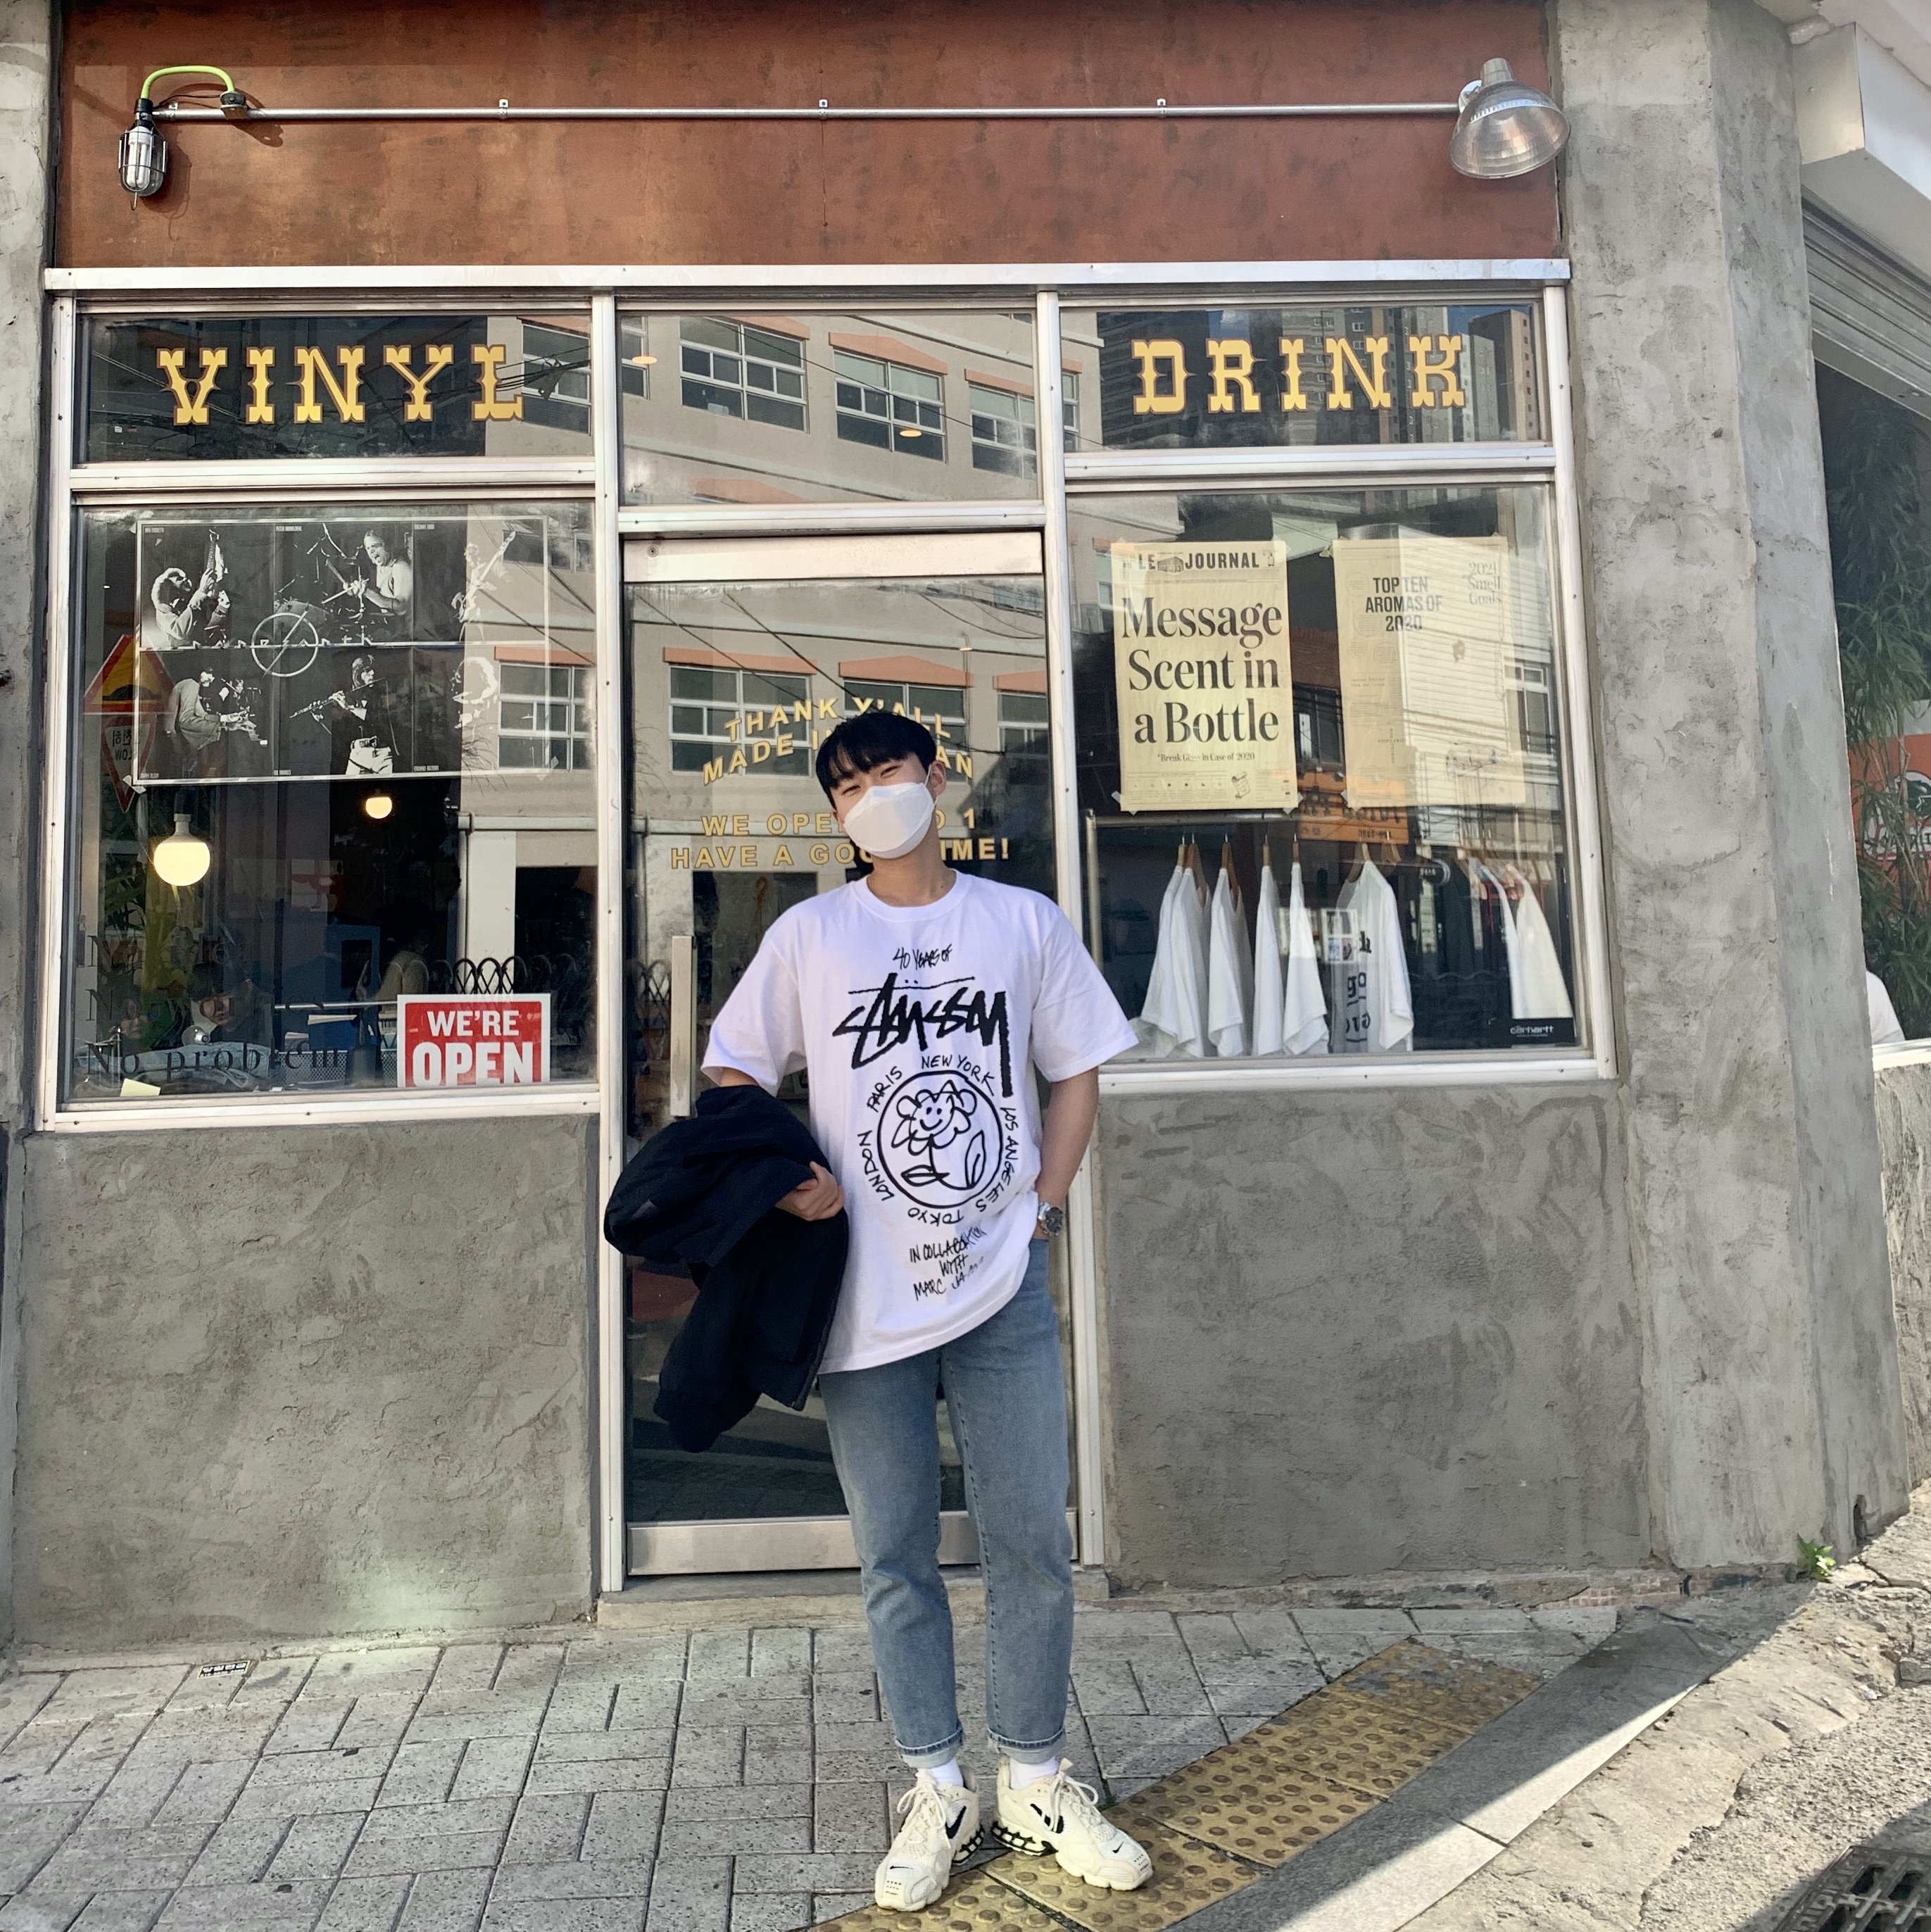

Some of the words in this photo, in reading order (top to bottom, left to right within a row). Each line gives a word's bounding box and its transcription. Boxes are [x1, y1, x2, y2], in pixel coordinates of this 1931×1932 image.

[156, 344, 524, 425] VINYL
[1131, 334, 1465, 415] DRINK
[1139, 553, 1156, 570] LE
[1185, 553, 1259, 570] JOURNAL
[1373, 577, 1399, 594] TOP
[1404, 576, 1429, 593] TEN
[1468, 575, 1502, 591] Smell
[1366, 596, 1424, 613] AROMAS
[1426, 595, 1443, 611] OF
[1122, 597, 1283, 648] Message
[1128, 648, 1235, 690] Scent
[1245, 651, 1281, 689] in
[723, 698, 839, 742] THANK
[1134, 714, 1157, 744] a
[1165, 698, 1280, 744] Bottle
[703, 732, 794, 786] MADE
[812, 729, 832, 751] I
[1228, 753, 1235, 761] of
[1236, 753, 1255, 761] 2020
[701, 815, 750, 836] WE
[964, 808, 976, 829] 1
[671, 846, 757, 869] HAVE
[773, 845, 794, 866] A
[939, 837, 1009, 861] IME!
[893, 946, 910, 970] 40
[912, 948, 941, 970] YEARS
[941, 943, 953, 962] OF
[427, 1010, 520, 1036] WE'RE
[85, 1043, 139, 1074] No
[413, 1042, 534, 1087] OPEN
[867, 1065, 902, 1112] PARIS
[922, 1055, 952, 1069] NEW
[957, 1055, 995, 1096] YORK
[1000, 1107, 1019, 1131] LOS
[857, 1130, 894, 1201] LONDON
[976, 1136, 1019, 1212] ANGELES
[907, 1208, 964, 1227] TOKYO
[910, 1244, 921, 1263] IN
[939, 1254, 969, 1276] WITH
[913, 1278, 947, 1301] MARC
